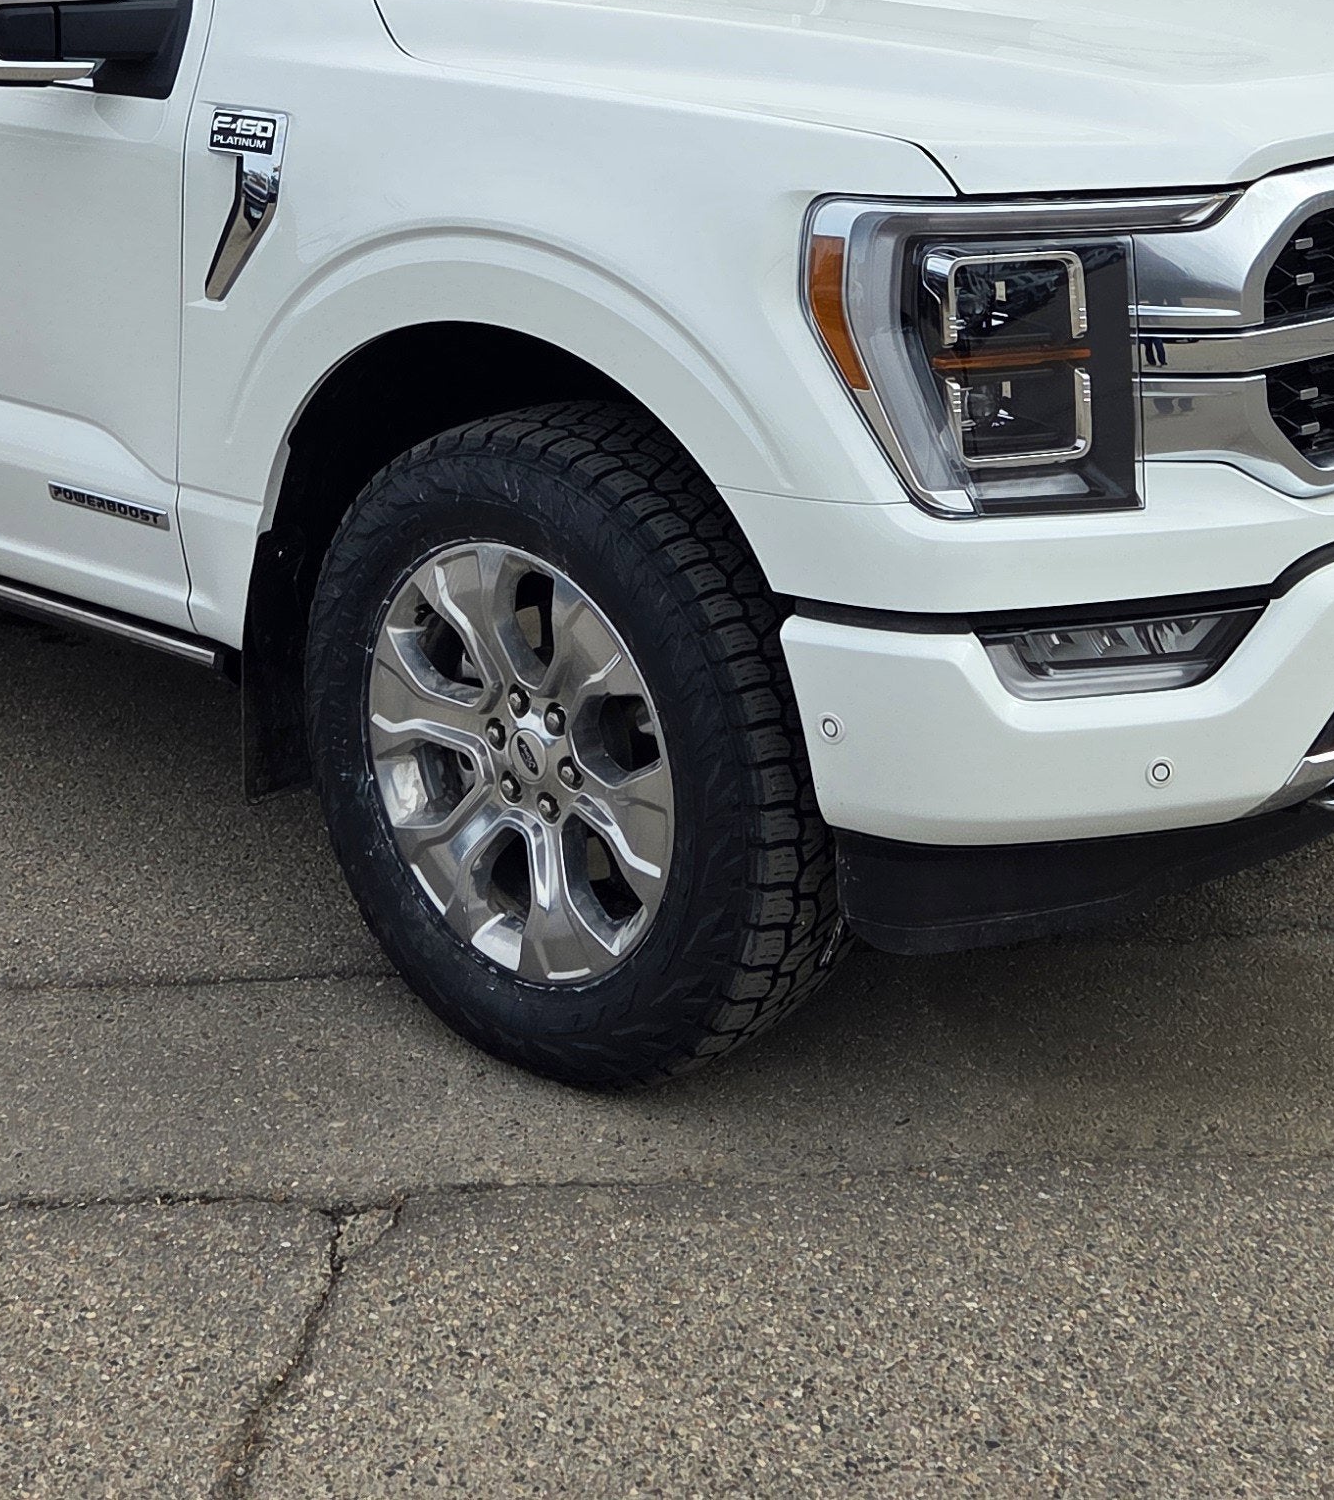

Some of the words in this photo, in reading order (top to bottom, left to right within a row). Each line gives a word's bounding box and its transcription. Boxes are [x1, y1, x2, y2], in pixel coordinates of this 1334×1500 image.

[212, 115, 275, 138] F-150
[213, 134, 266, 149] PLATINUM
[53, 487, 160, 525] POWERBOOST
